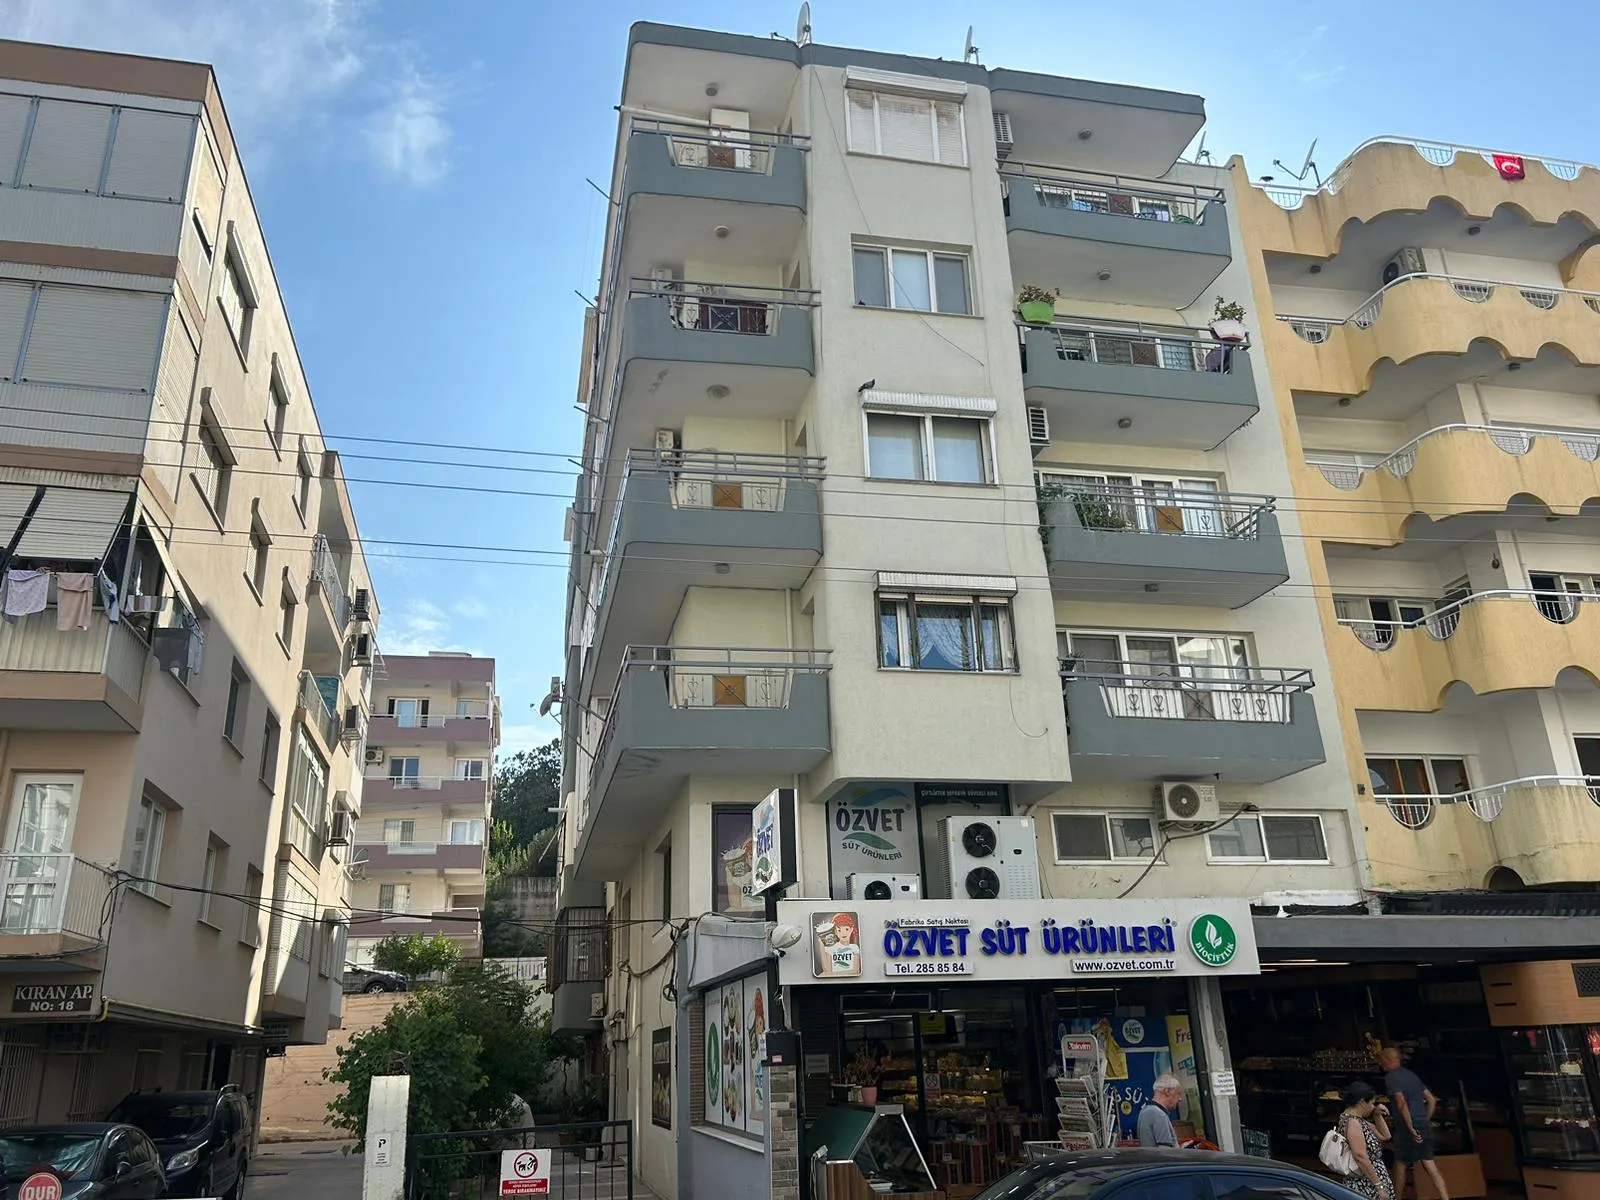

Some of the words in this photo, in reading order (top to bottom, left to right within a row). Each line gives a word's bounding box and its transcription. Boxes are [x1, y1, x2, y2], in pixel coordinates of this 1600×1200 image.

[836, 801, 905, 832] ÖZVET
[842, 841, 860, 850] SÜT
[861, 846, 902, 861] ÜRÜNLERİ
[884, 920, 970, 958] ÖZVET
[979, 919, 1029, 956] SÜT
[1040, 918, 1176, 955] ÜRÜNLERİ
[894, 964, 914, 973] Tel.
[916, 964, 935, 973] 285
[937, 964, 950, 972] 85
[952, 963, 965, 972] 84
[1075, 959, 1174, 971] www.ozvet.com.tr
[15, 986, 68, 1000] KIRAN
[71, 985, 93, 999] AP.
[30, 1001, 54, 1011] NO:
[58, 1001, 74, 1011] 18
[1175, 1028, 1192, 1043] Fre
[25, 1185, 57, 1200] DUR
